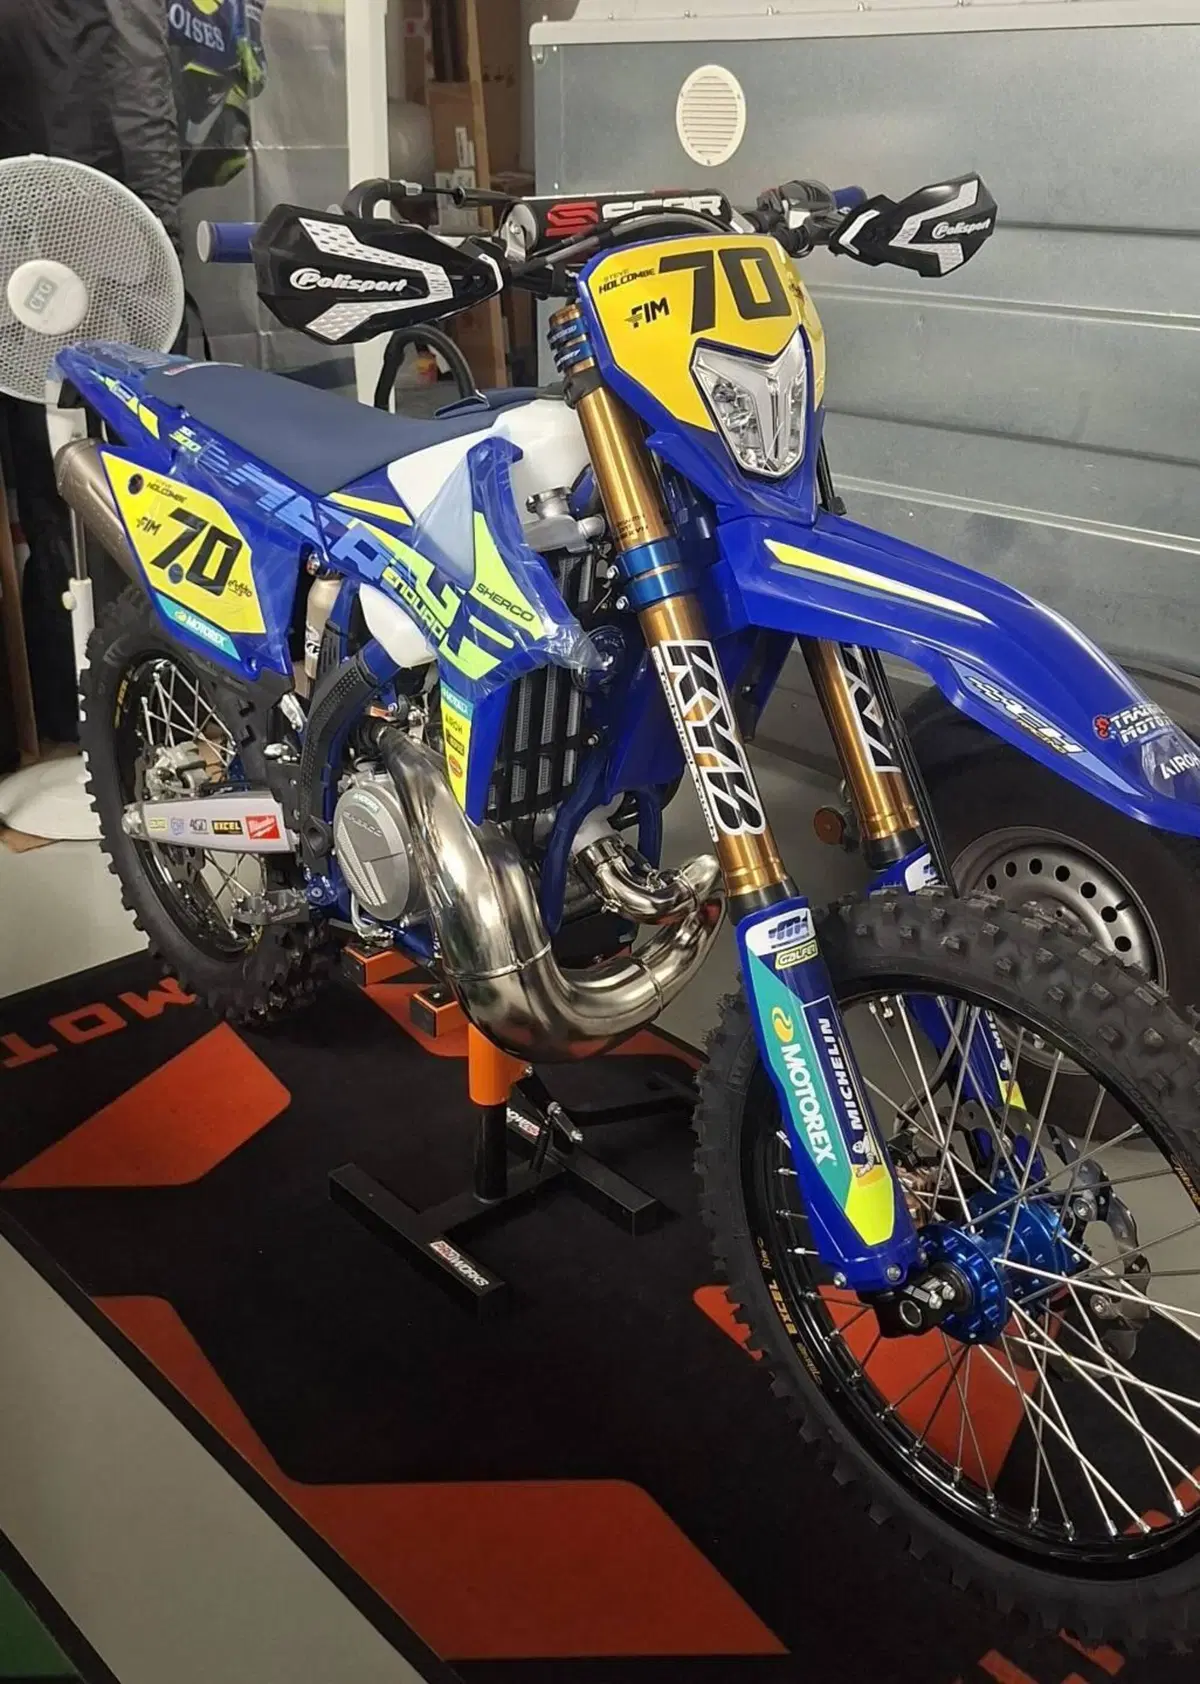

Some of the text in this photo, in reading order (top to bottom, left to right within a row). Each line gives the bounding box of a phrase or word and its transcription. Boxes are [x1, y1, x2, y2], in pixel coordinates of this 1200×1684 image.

[289, 267, 408, 292] Polisport
[598, 267, 656, 294] HOLCOMBE
[658, 247, 792, 335] 70
[627, 297, 670, 328] FIM
[149, 507, 243, 597] 70
[382, 567, 446, 638] ENDURO
[475, 581, 536, 622] SHERCO
[186, 615, 225, 648] MOTOREX
[659, 640, 767, 836] KYB
[214, 820, 241, 831] EXCEL
[817, 1017, 865, 1131] MICHELIN
[780, 1043, 837, 1165] MOTOREX
